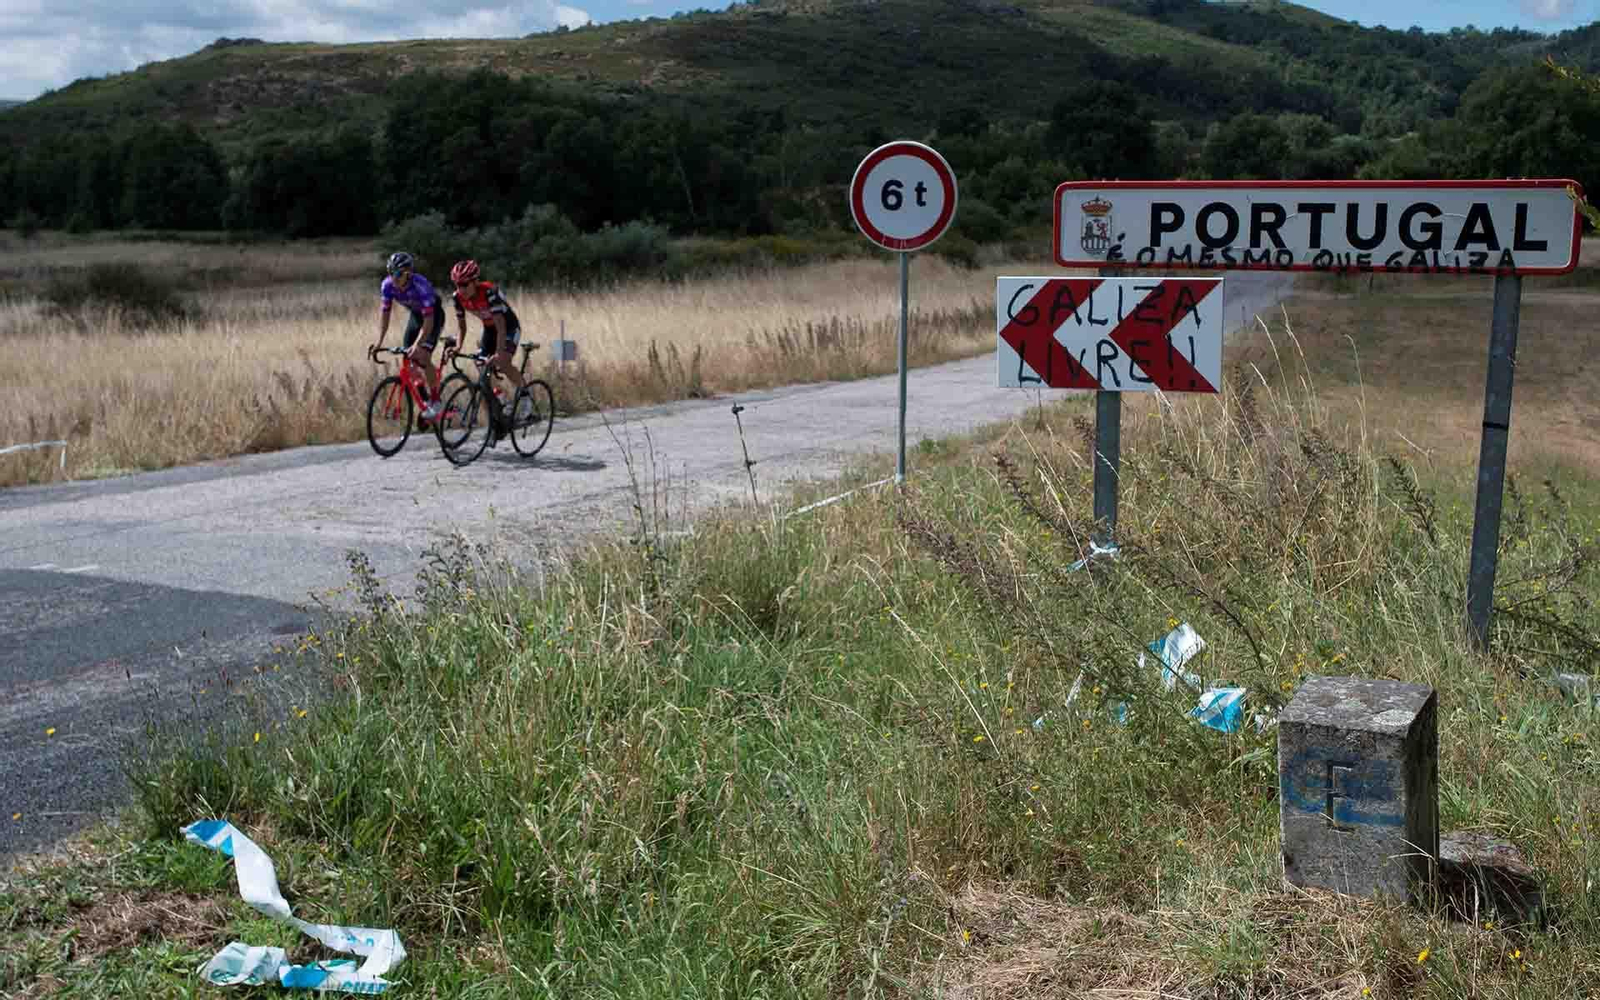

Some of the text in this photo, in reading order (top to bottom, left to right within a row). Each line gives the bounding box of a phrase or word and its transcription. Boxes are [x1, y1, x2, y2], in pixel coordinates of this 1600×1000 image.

[881, 179, 928, 212] 6 t
[1150, 201, 1548, 252] PORTUGAL
[1136, 246, 1156, 267] O
[1167, 243, 1295, 269] MESMO
[1312, 248, 1372, 270] QUE
[1384, 248, 1516, 272] GALIZA
[1007, 283, 1202, 329] GALIZA
[1017, 332, 1197, 389] LIVRE!!
